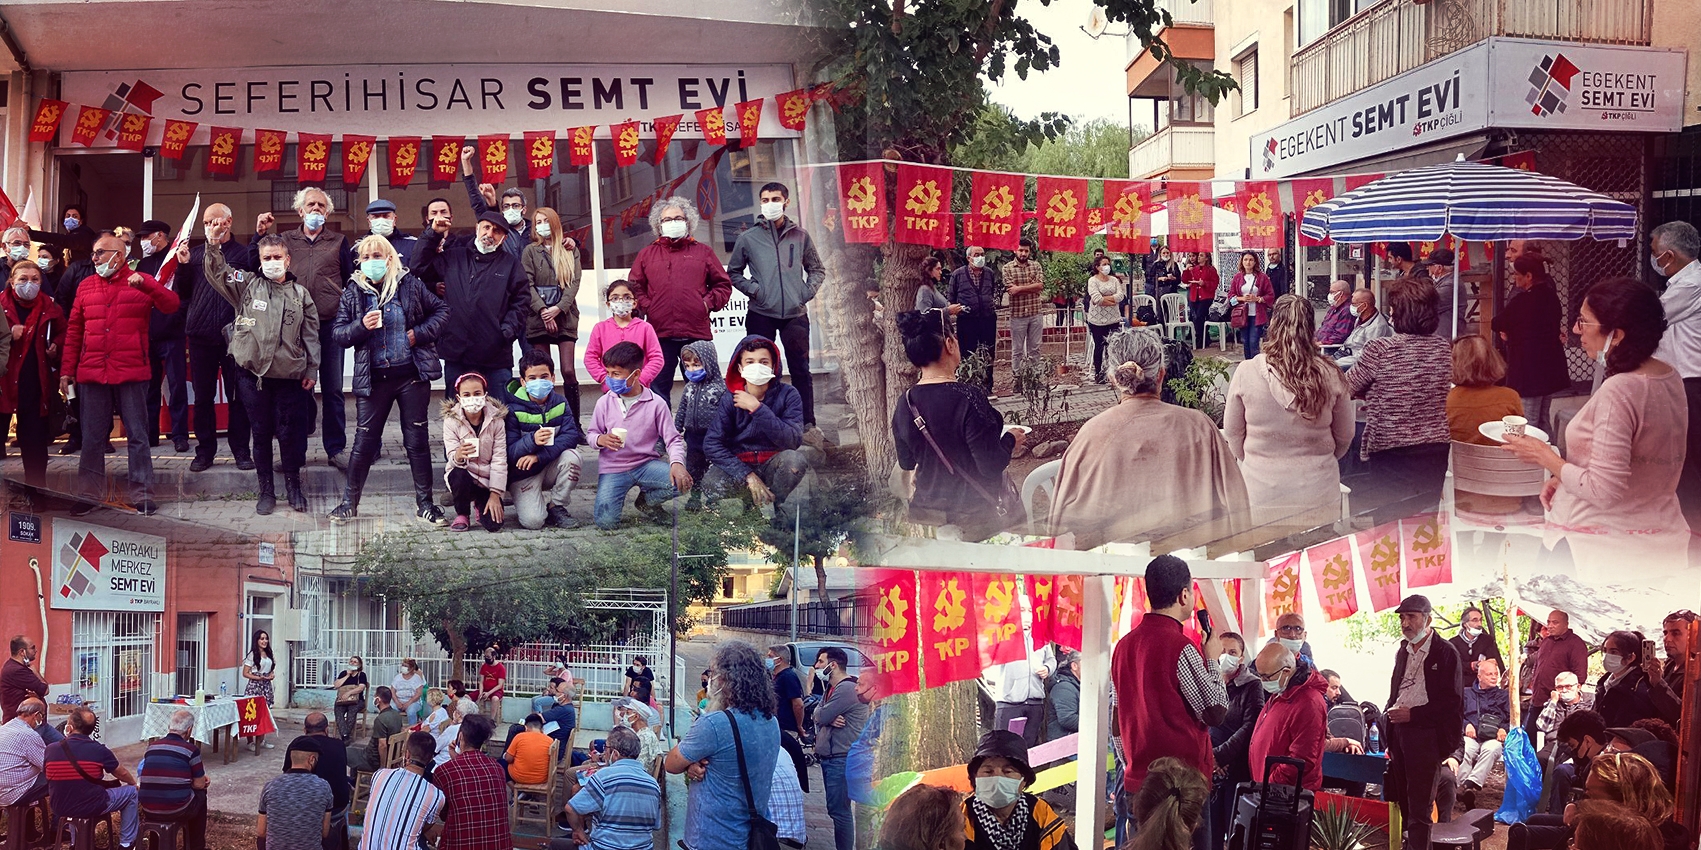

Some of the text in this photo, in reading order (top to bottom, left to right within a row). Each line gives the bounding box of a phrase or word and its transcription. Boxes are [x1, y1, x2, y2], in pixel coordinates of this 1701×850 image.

[1582, 71, 1657, 91] EGEKENT
[180, 70, 748, 116] SEFERİHİSAR SEMT EVİ
[1581, 90, 1655, 109] SEMT EVİ
[1280, 69, 1460, 160] EGEKENT SEMT EVİ
[34, 125, 53, 133] TKP
[1420, 110, 1463, 135] TKP ÇİĞLİ
[77, 126, 96, 138] TKP
[122, 132, 142, 142] TKP
[708, 130, 726, 140] TK
[573, 147, 590, 156] TK
[620, 148, 638, 159] TK
[211, 155, 233, 165] TKP
[303, 162, 325, 171] TKP
[532, 157, 553, 168] TKP
[439, 164, 456, 174] TKP
[486, 164, 507, 174] TKP
[848, 215, 880, 229] TKP
[904, 216, 940, 231] TKP
[980, 221, 1013, 235] TKP
[1044, 224, 1078, 238] TKP
[1112, 226, 1142, 239] TKP
[1178, 226, 1205, 240] TKP
[1246, 226, 1276, 237] TKP
[111, 540, 159, 559] BAYRAKLI
[111, 559, 152, 576] MERKEZ
[1412, 554, 1446, 569] TKP
[110, 577, 155, 594] SEMT EVİ
[1325, 588, 1353, 606] TKP
[934, 638, 970, 661] TKP
[873, 649, 910, 674] TKP
[243, 724, 258, 734] TKP
